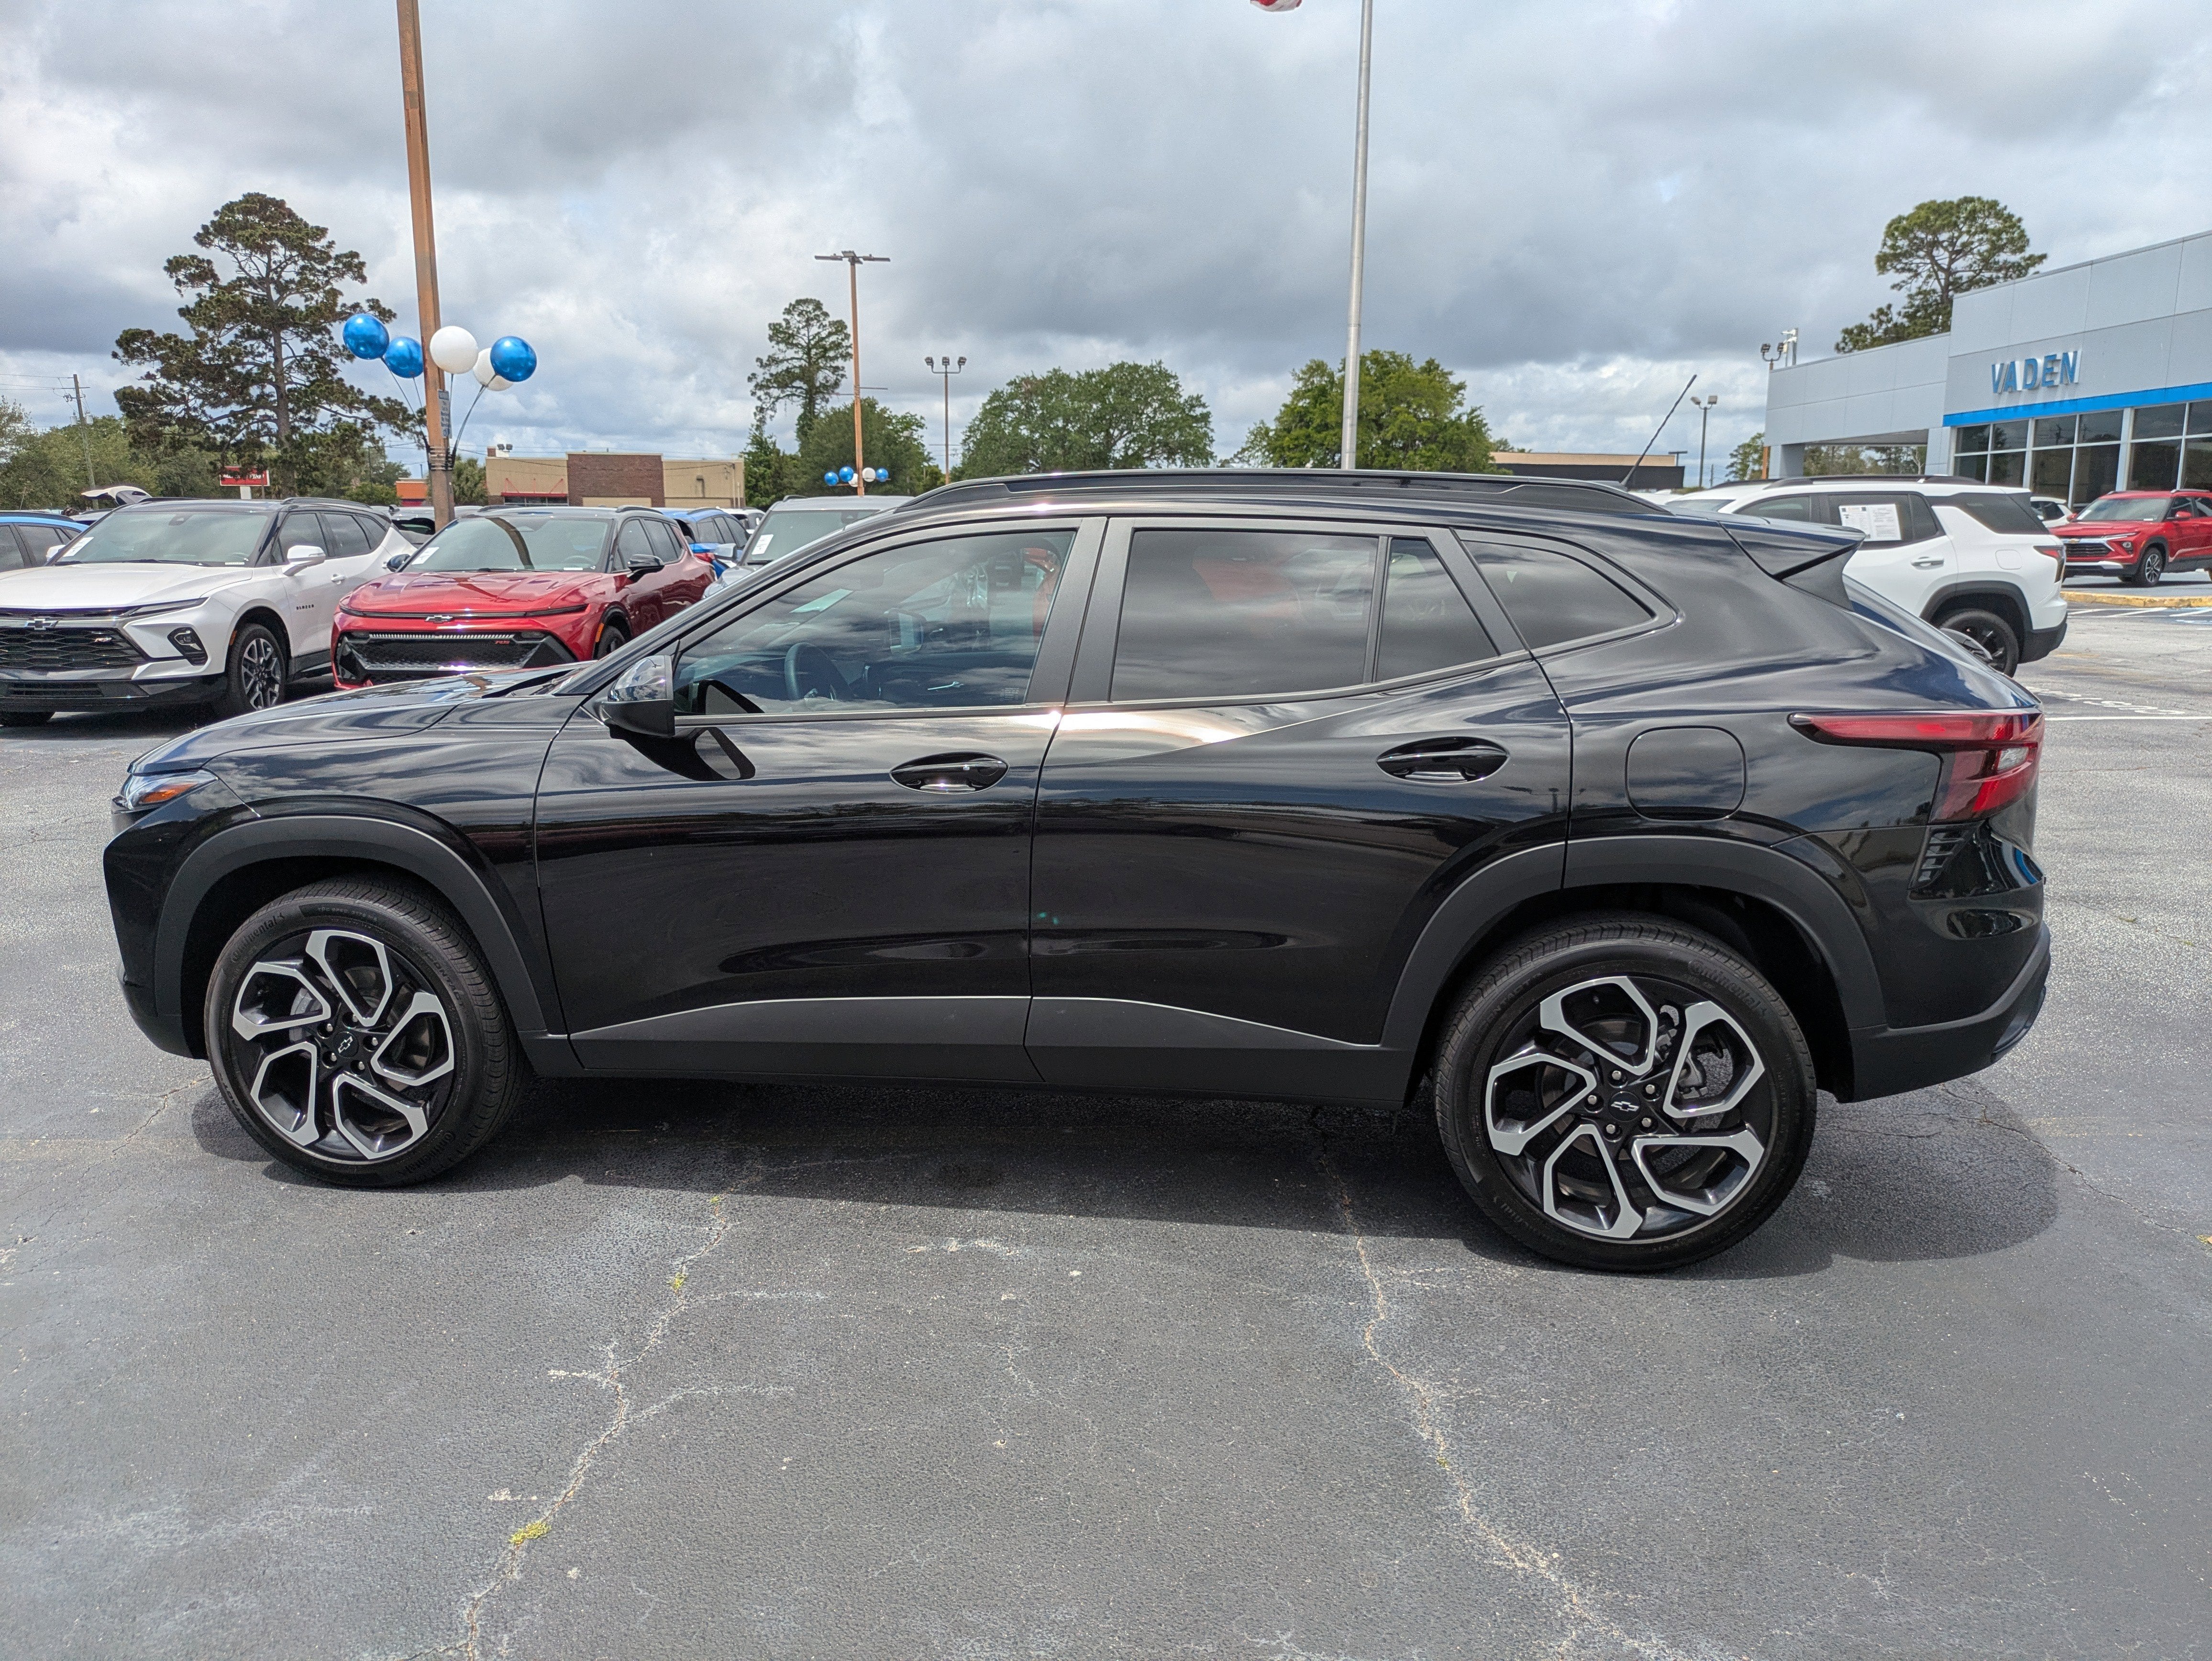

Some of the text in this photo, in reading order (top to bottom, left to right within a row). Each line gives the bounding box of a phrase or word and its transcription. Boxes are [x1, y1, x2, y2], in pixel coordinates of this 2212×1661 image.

[1991, 350, 2079, 394] VADEN
[231, 915, 277, 963] Continental
[1688, 959, 1761, 1008] Continental
